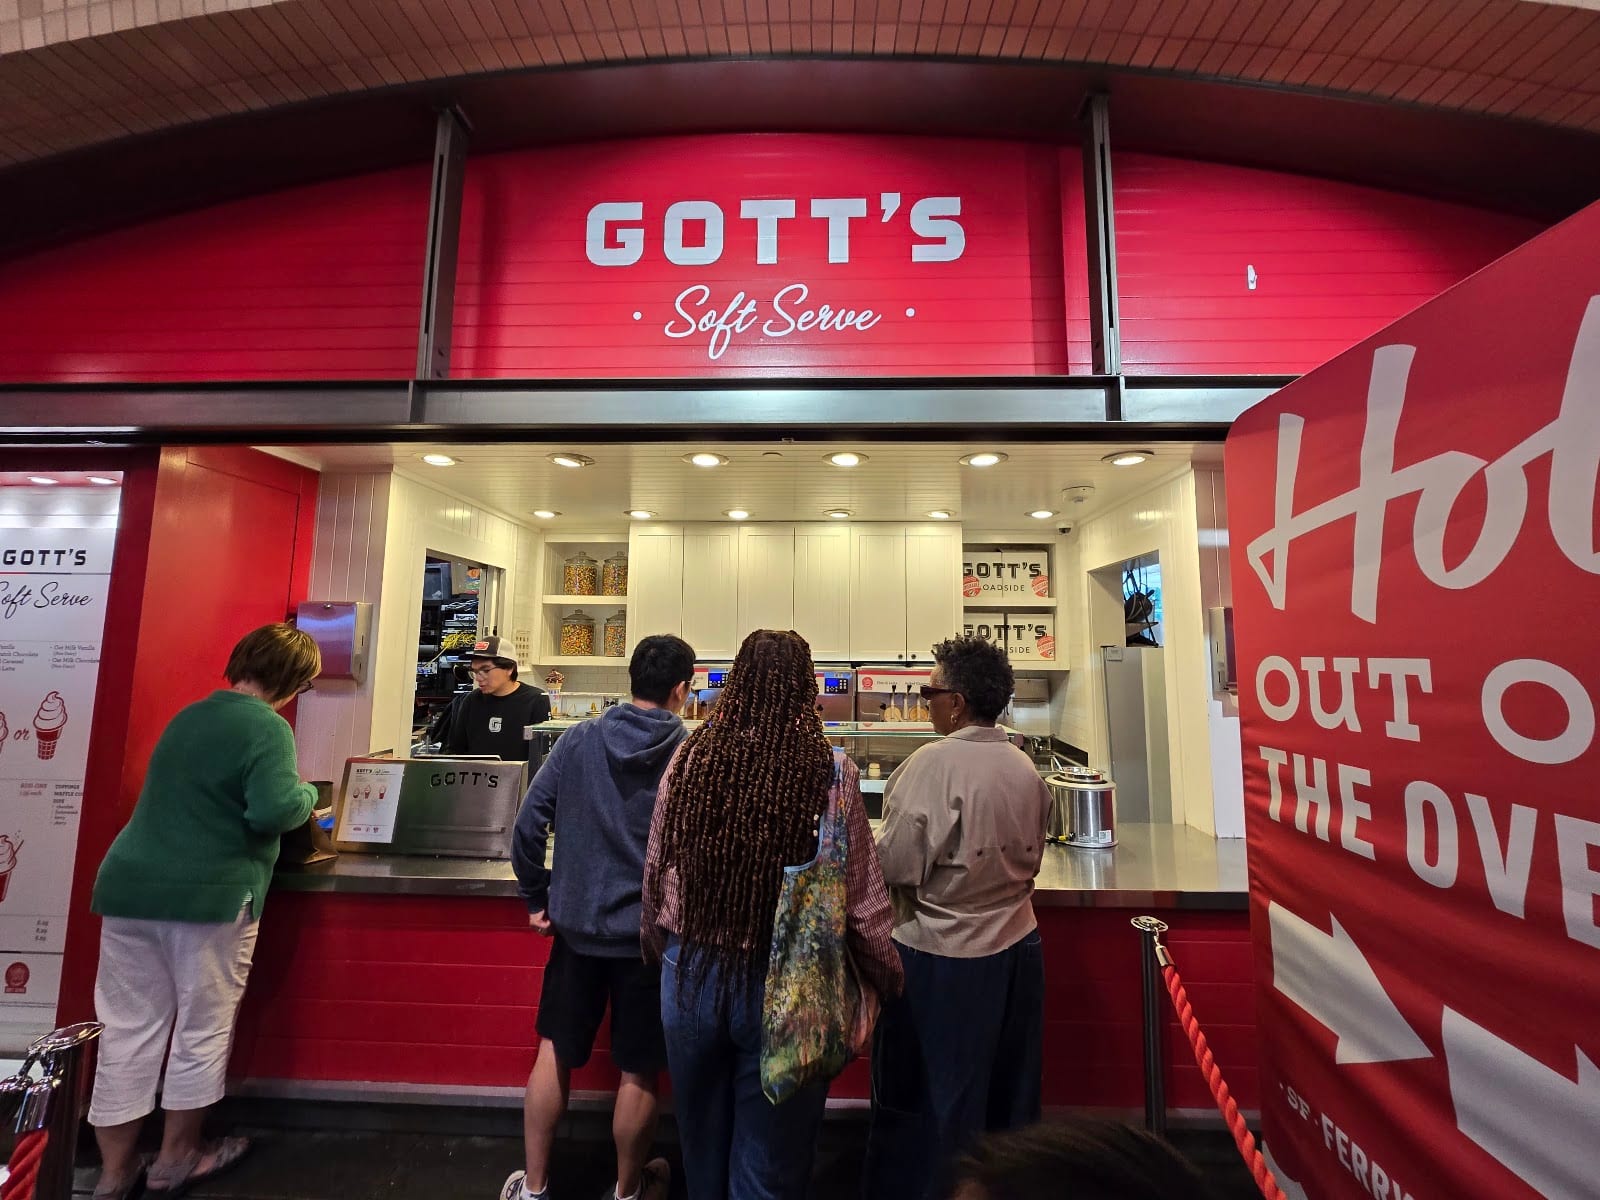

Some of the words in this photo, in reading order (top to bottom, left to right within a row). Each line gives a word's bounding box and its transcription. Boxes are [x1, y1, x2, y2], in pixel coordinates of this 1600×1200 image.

[585, 192, 966, 267] GOTT'S
[664, 284, 757, 360] Soft
[762, 283, 882, 338] Serve
[3, 548, 87, 566] GOTT'S
[33, 581, 93, 609] Serve
[982, 584, 1025, 592] OADSIDE
[1256, 655, 1432, 742] OUT
[13, 728, 30, 741] or
[489, 717, 502, 732] G
[430, 772, 499, 788] GOTT'S
[1259, 745, 1376, 861] THE
